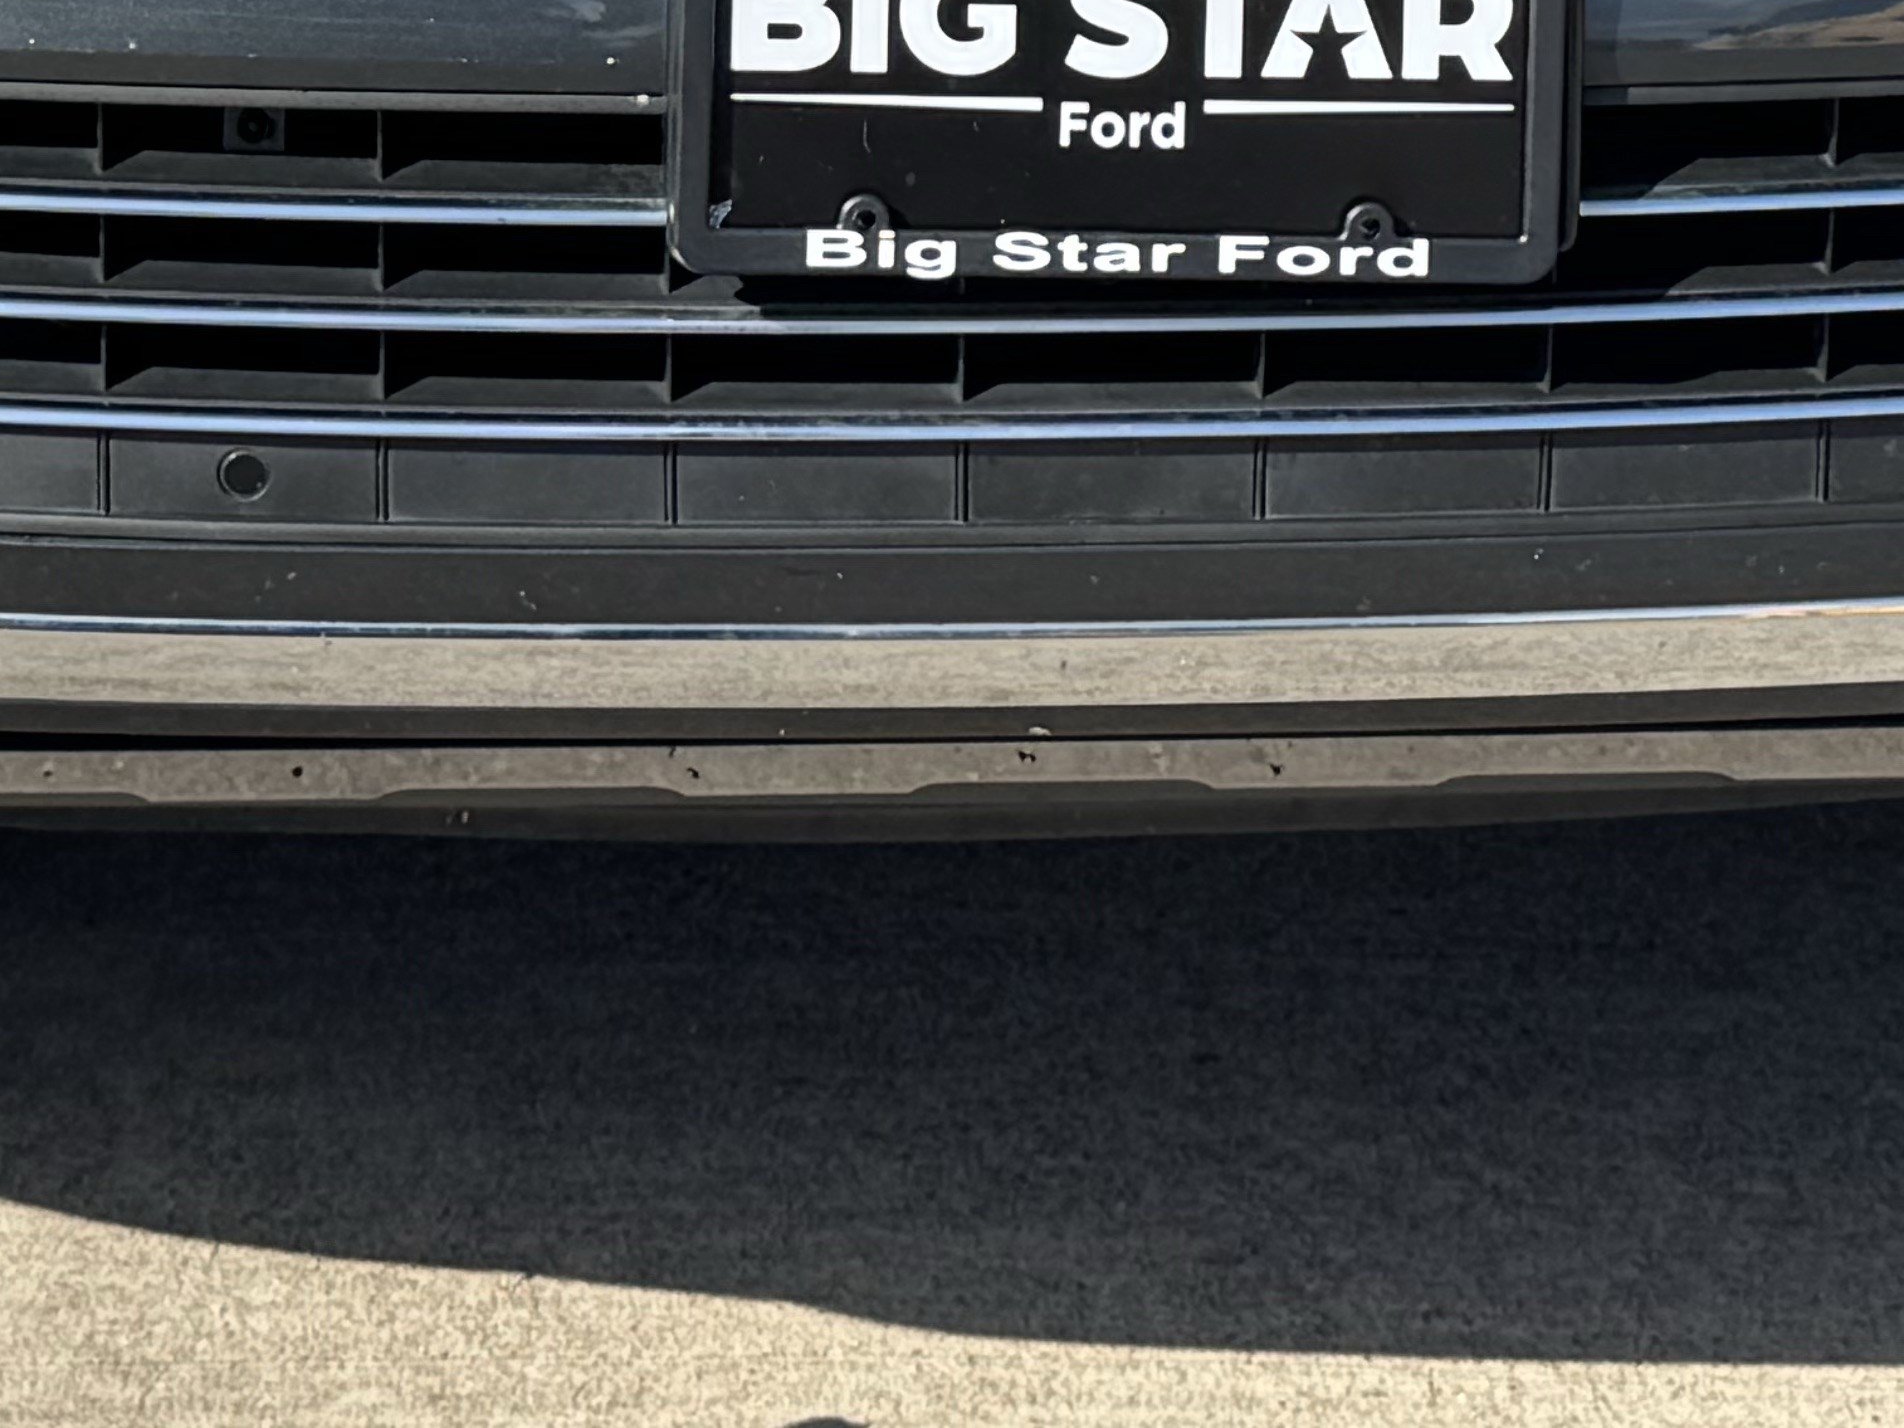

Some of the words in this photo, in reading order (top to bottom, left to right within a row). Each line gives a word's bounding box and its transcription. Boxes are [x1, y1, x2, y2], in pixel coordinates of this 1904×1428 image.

[1059, 100, 1186, 150] Ford
[805, 223, 957, 280] Big
[992, 231, 1187, 274] Star
[1217, 234, 1430, 278] Ford
